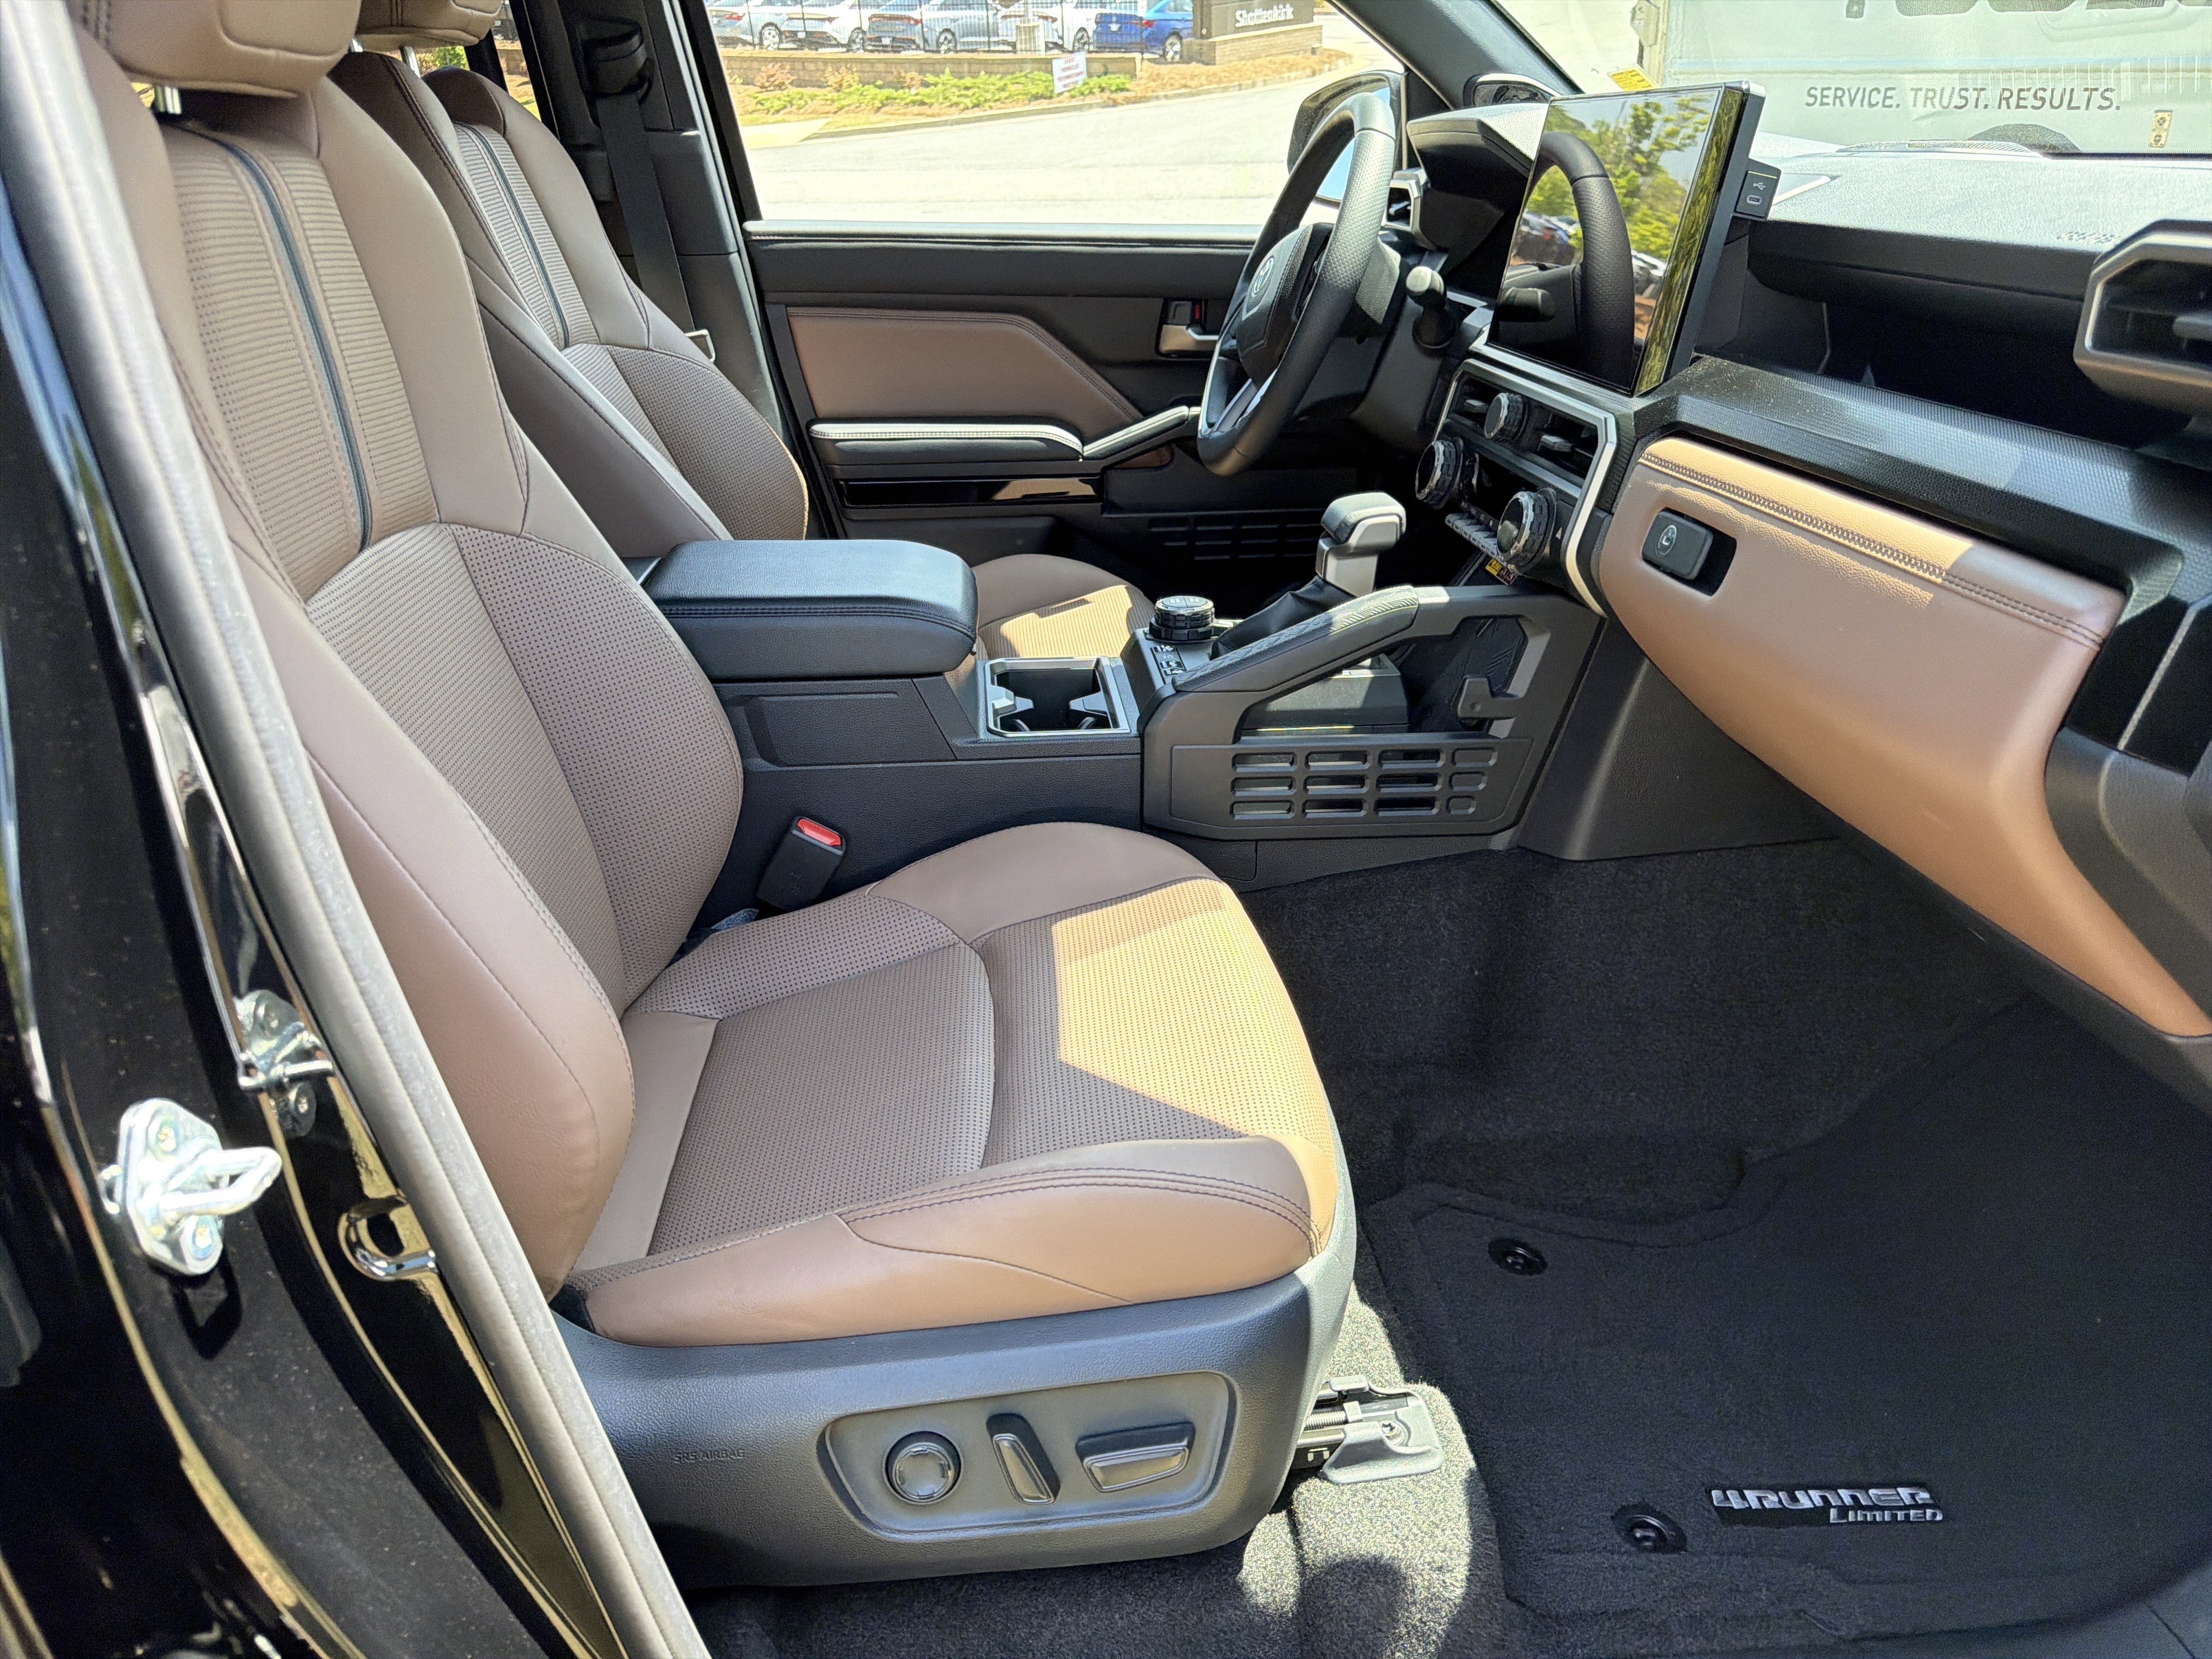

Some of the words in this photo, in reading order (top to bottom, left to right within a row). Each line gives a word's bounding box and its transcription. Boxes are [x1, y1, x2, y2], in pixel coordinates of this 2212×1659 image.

[1804, 86, 1900, 109] SERVICE.
[1910, 87, 1990, 110] TRUST.
[1997, 87, 2121, 111] RESULTS.
[700, 1448, 747, 1462] AIRBAG
